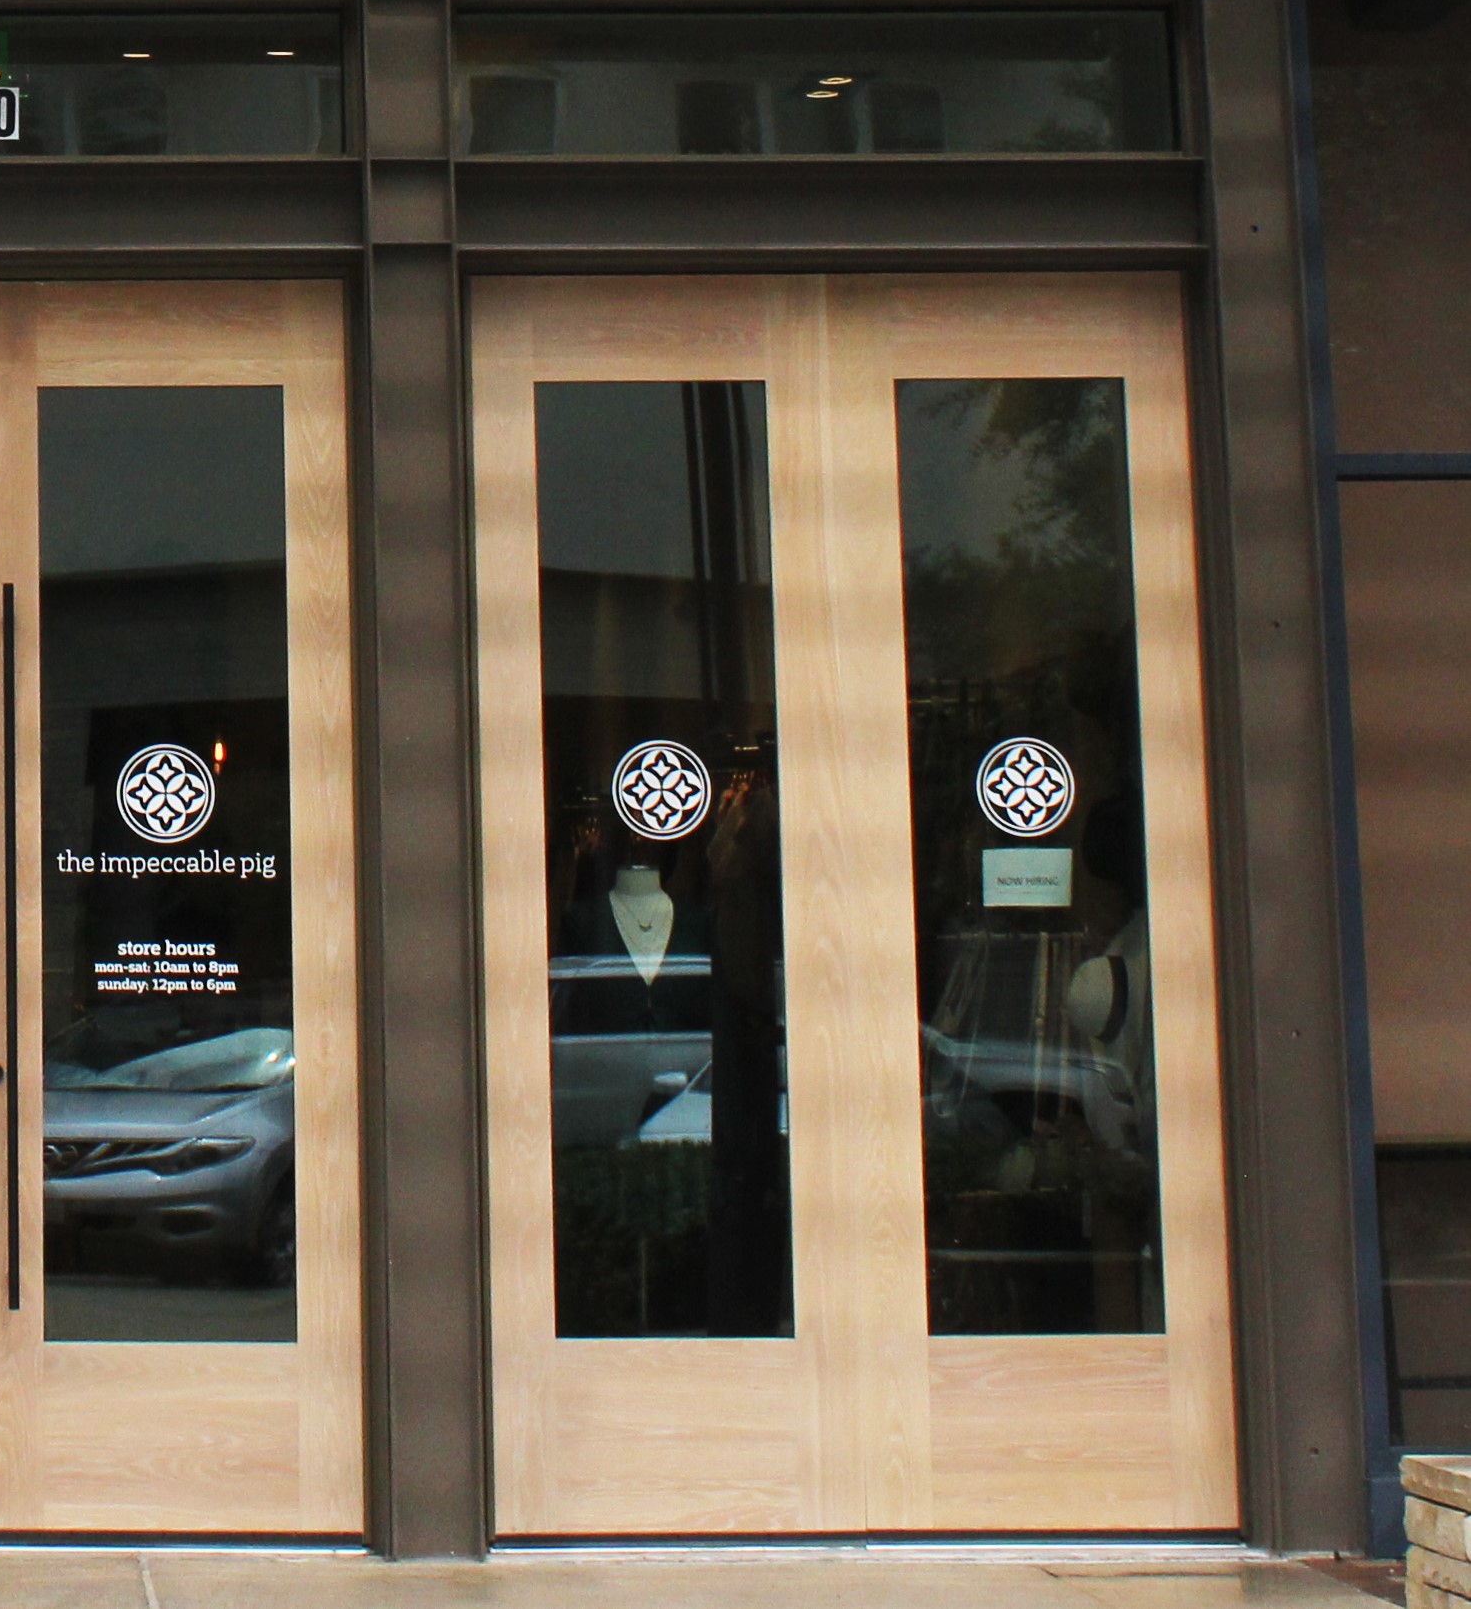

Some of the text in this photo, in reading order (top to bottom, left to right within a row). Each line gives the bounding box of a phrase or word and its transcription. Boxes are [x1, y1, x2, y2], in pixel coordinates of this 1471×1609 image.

[56, 848, 277, 879] the impeccable pig
[117, 939, 216, 956] store hours
[94, 961, 239, 977] mon-sat: 10am to 8pm
[97, 978, 237, 995] sunday: 12pm to 6pm
